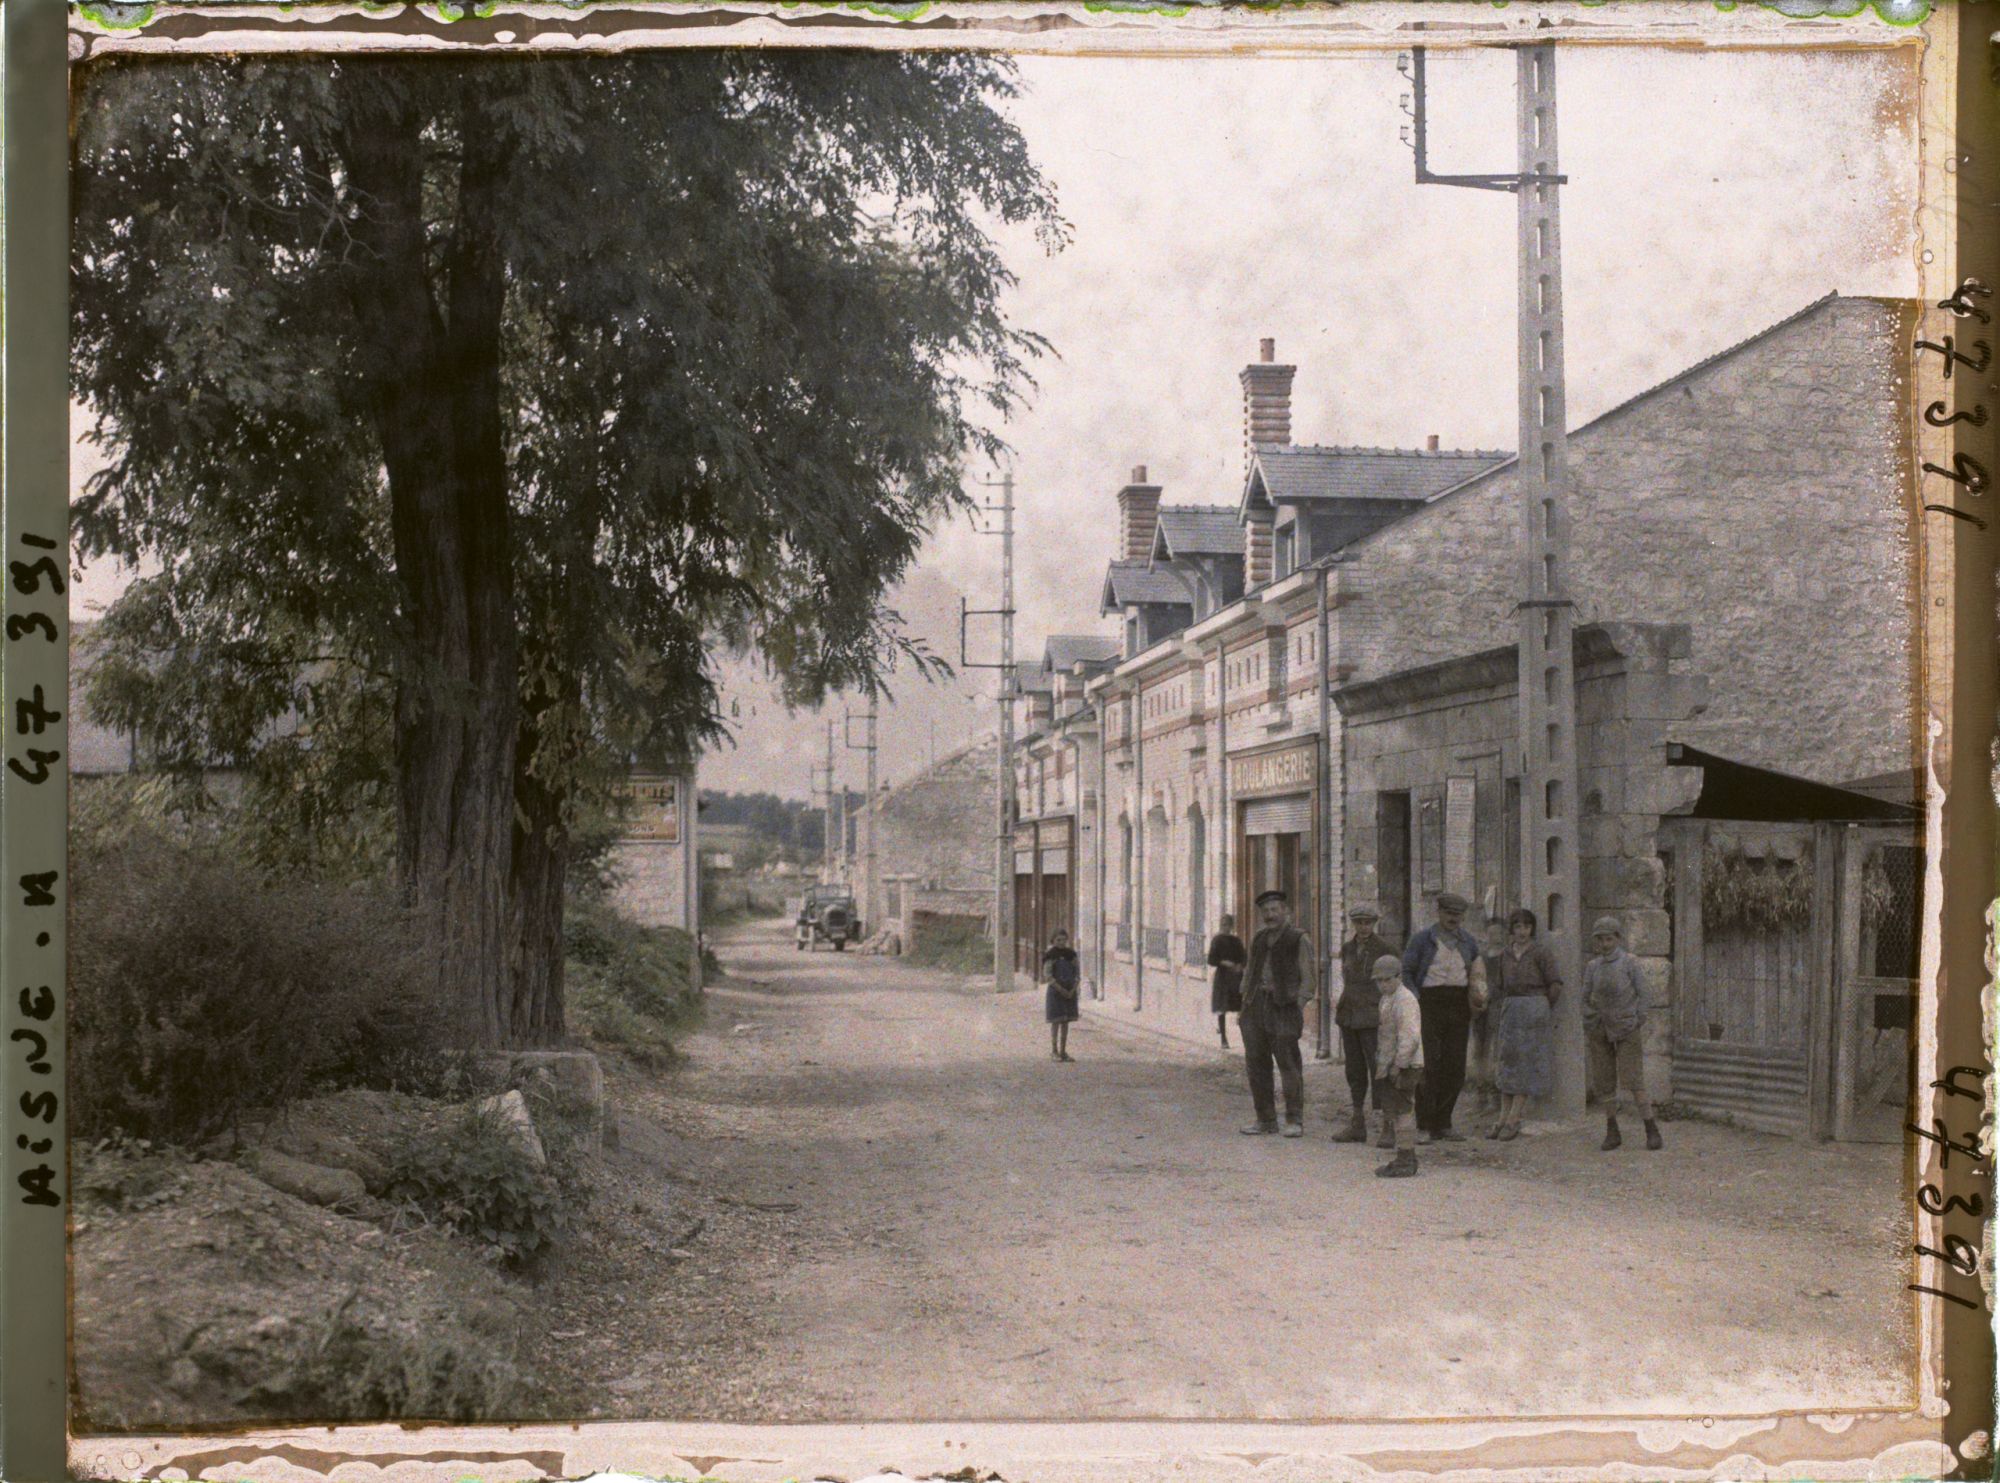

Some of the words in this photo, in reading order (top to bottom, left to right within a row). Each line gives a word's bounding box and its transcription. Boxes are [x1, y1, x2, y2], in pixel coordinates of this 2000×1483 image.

[1914, 282, 1992, 531] 47391
[1235, 750, 1312, 791] BOULANGERIE
[1906, 1066, 1984, 1309] 47391
